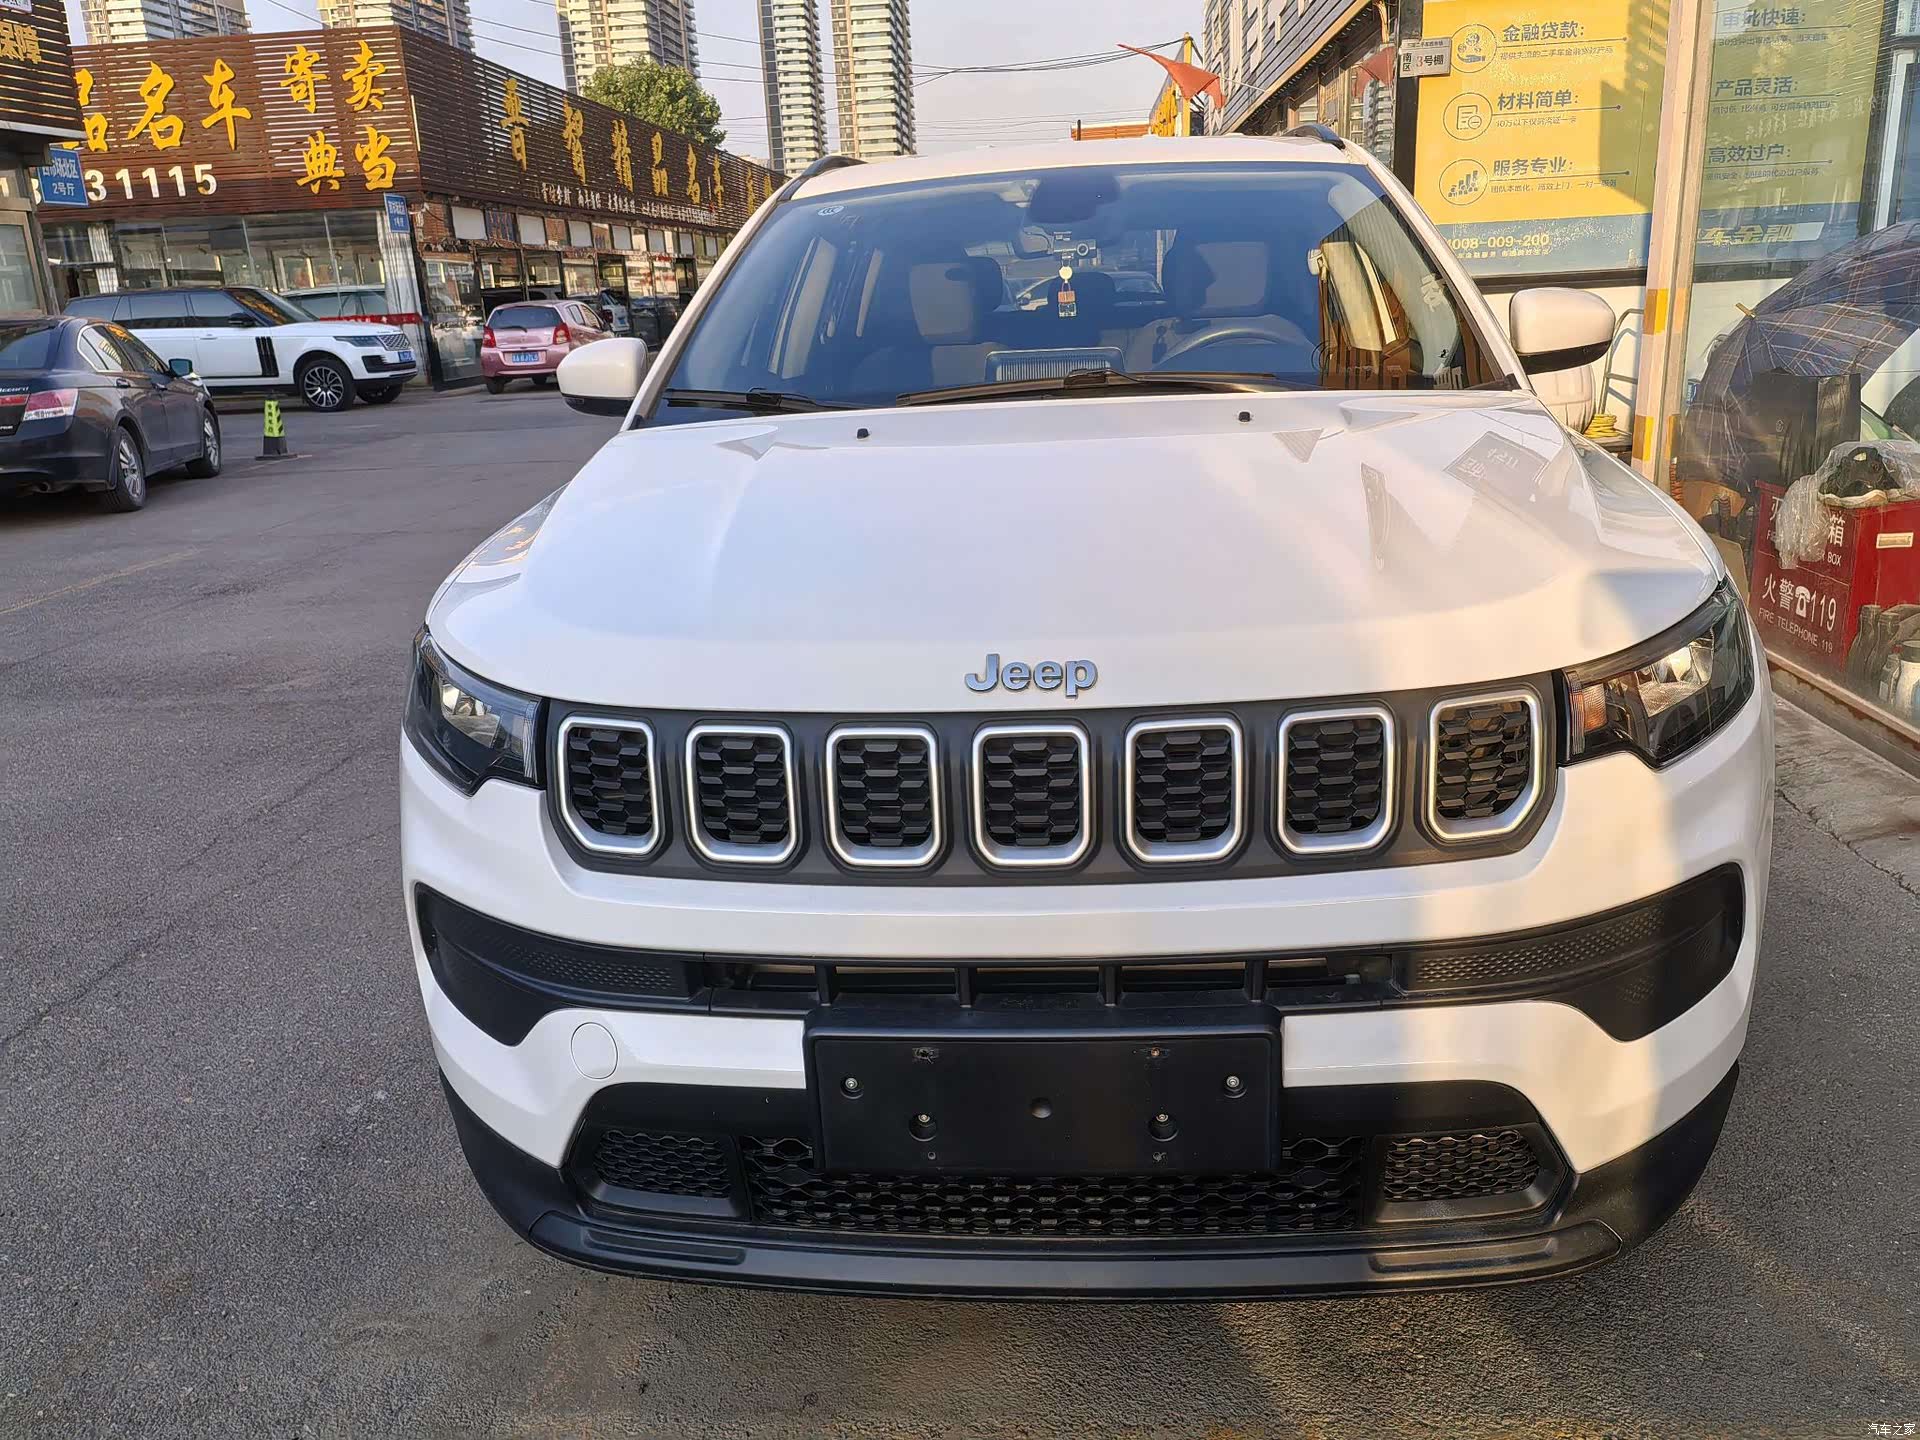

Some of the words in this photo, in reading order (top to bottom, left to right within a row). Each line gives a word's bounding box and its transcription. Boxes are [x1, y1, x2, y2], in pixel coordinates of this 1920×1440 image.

[280, 39, 390, 114] 寄卖
[296, 125, 397, 195] 典当
[52, 182, 75, 196] 2号厅
[1762, 573, 1794, 612] 火警
[1809, 589, 1837, 632] 119
[1758, 607, 1775, 625] FIRE
[1777, 615, 1819, 647] TELEPHONE
[1822, 640, 1834, 654] 119
[964, 653, 1098, 699] Jeep
